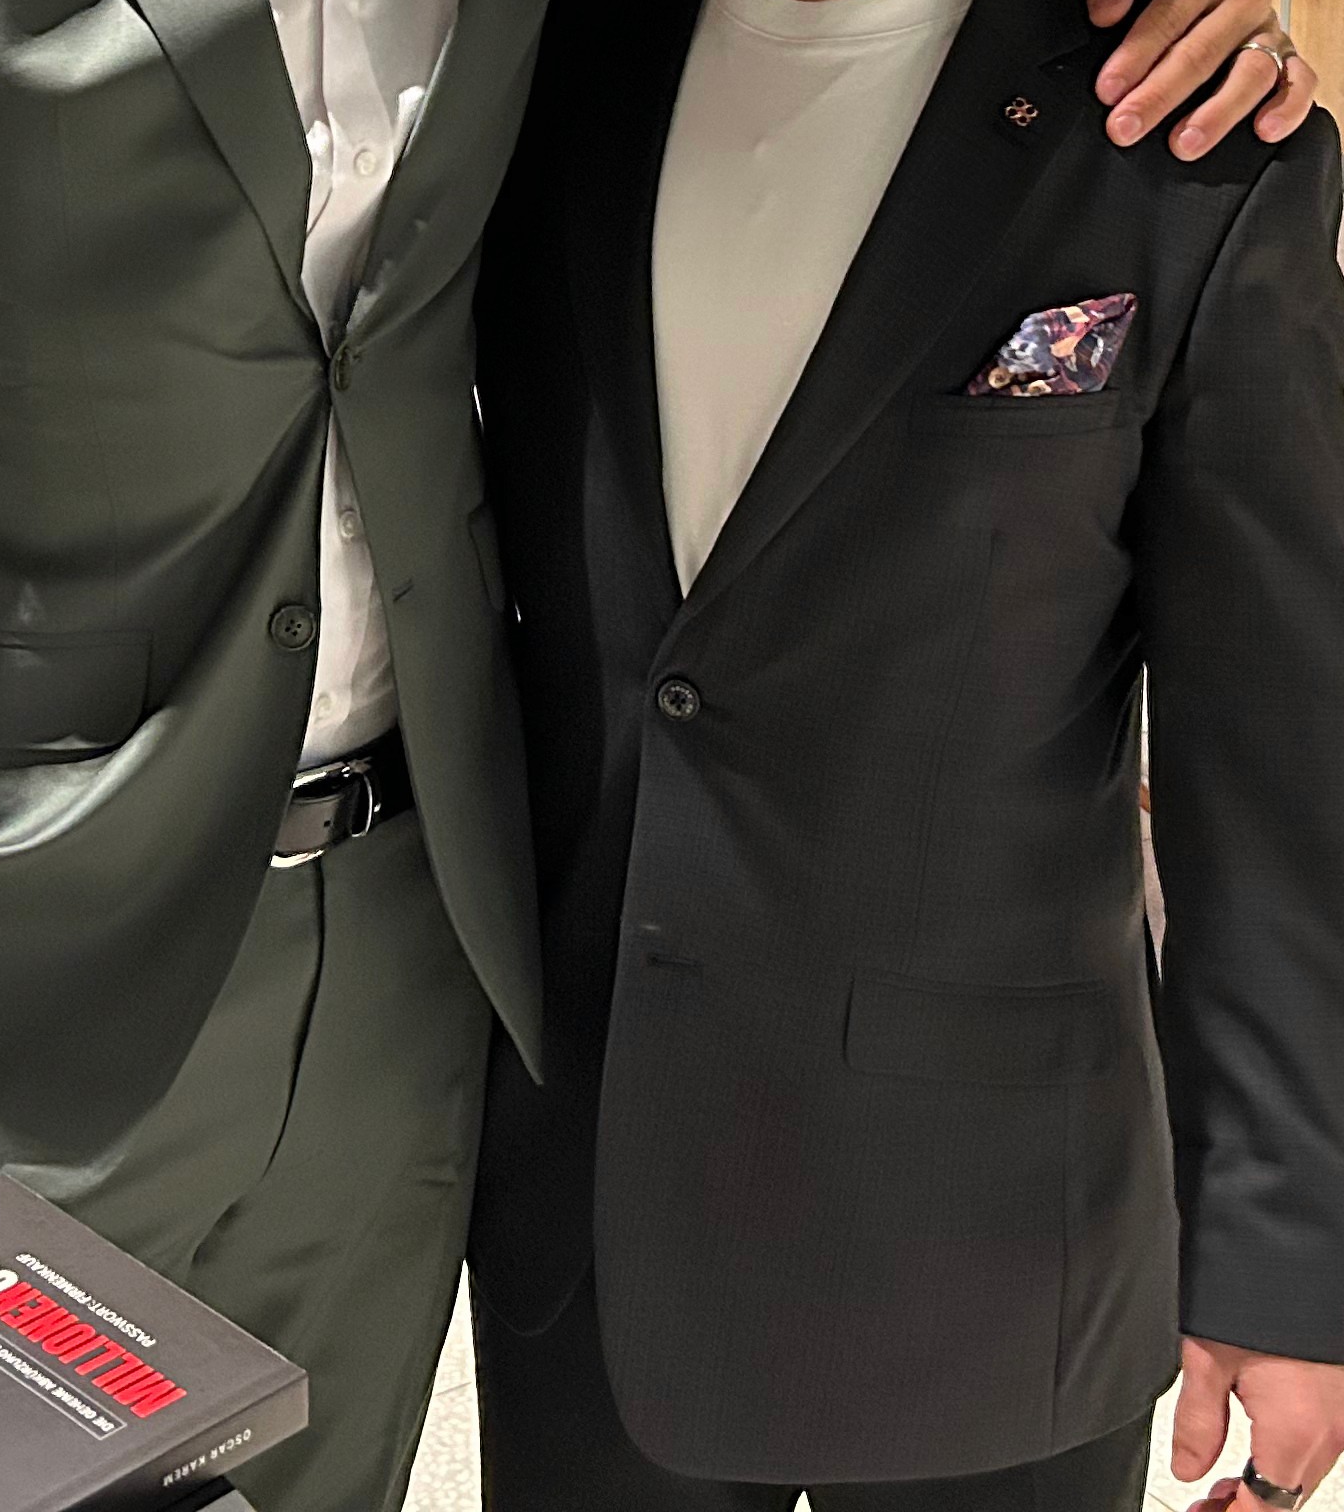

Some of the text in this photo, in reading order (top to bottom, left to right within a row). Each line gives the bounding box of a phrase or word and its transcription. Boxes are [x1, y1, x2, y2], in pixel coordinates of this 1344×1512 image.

[15, 1254, 92, 1305] FIRMENKAUF
[162, 1428, 252, 1487] OSCAR KAREM
